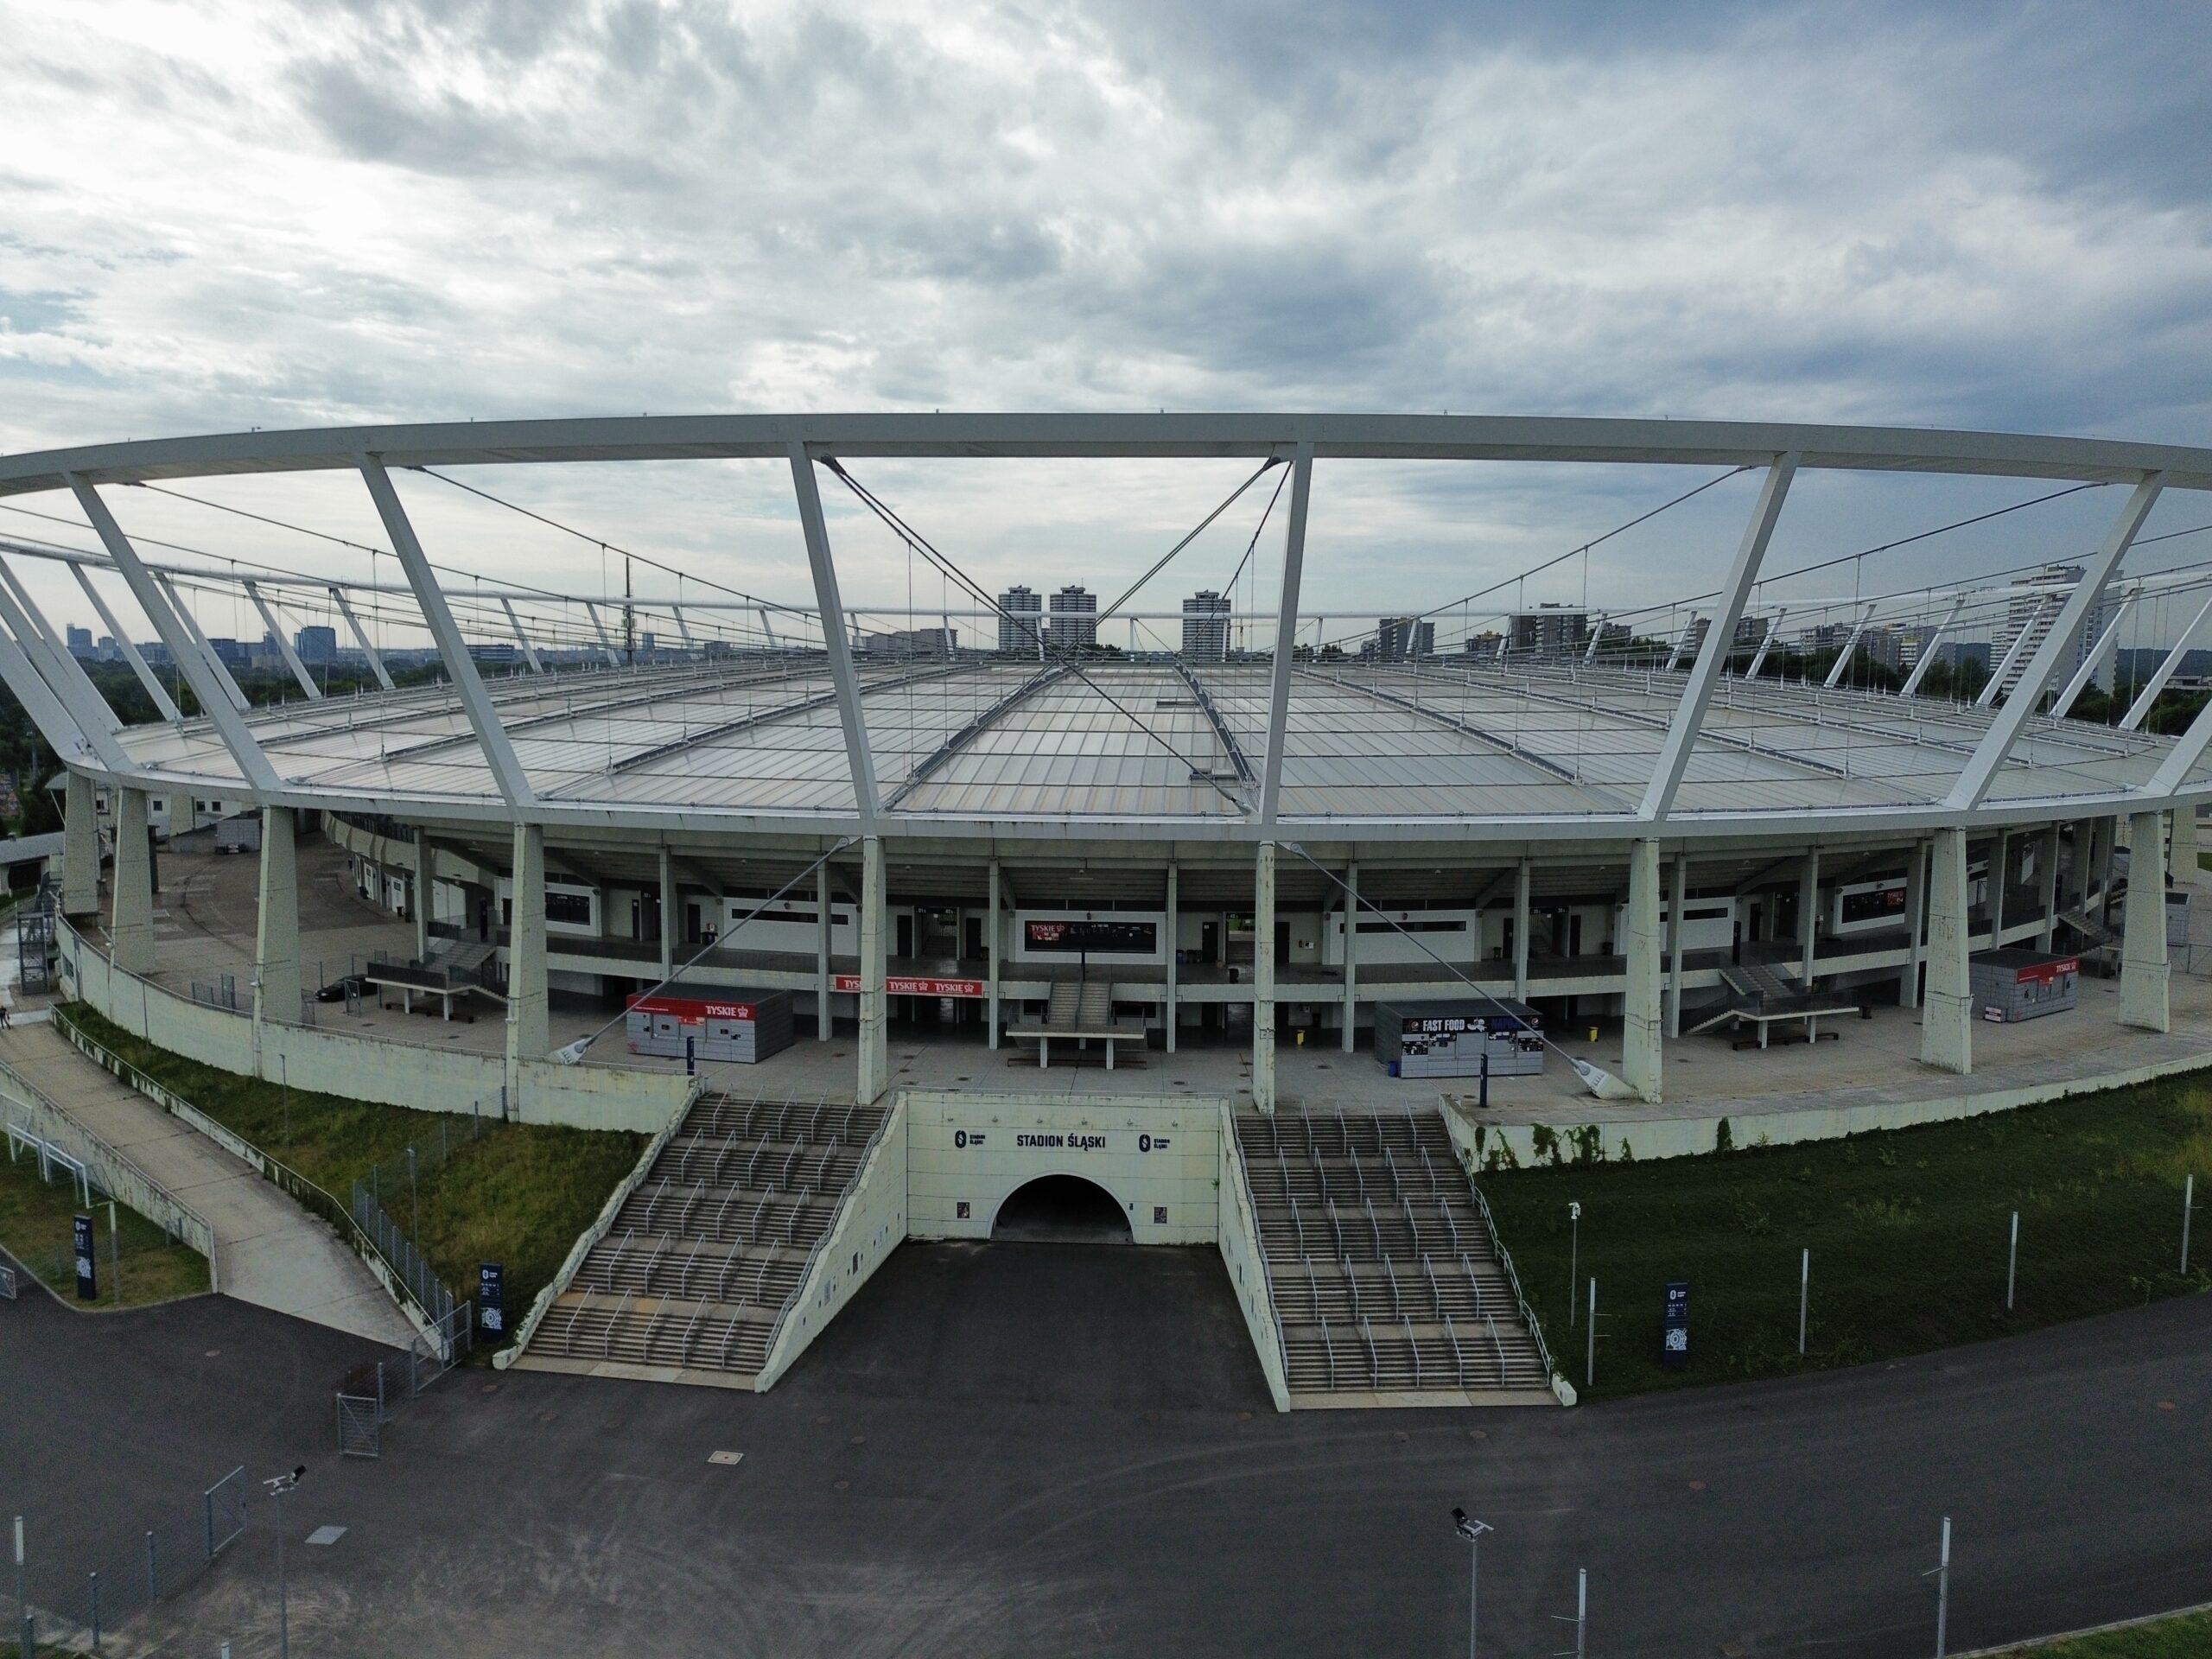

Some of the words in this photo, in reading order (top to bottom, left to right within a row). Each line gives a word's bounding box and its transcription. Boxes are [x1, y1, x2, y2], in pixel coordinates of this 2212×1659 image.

[844, 979, 861, 988] TYS
[889, 981, 918, 990] TYSKIE
[934, 982, 963, 993] TYSKIE
[705, 1005, 736, 1017] TYSKIE
[1422, 1020, 1442, 1032] FAST
[1444, 1019, 1465, 1031] FOOD
[1016, 1135, 1064, 1147] STADION
[1067, 1133, 1106, 1152] ŚLĄSKI
